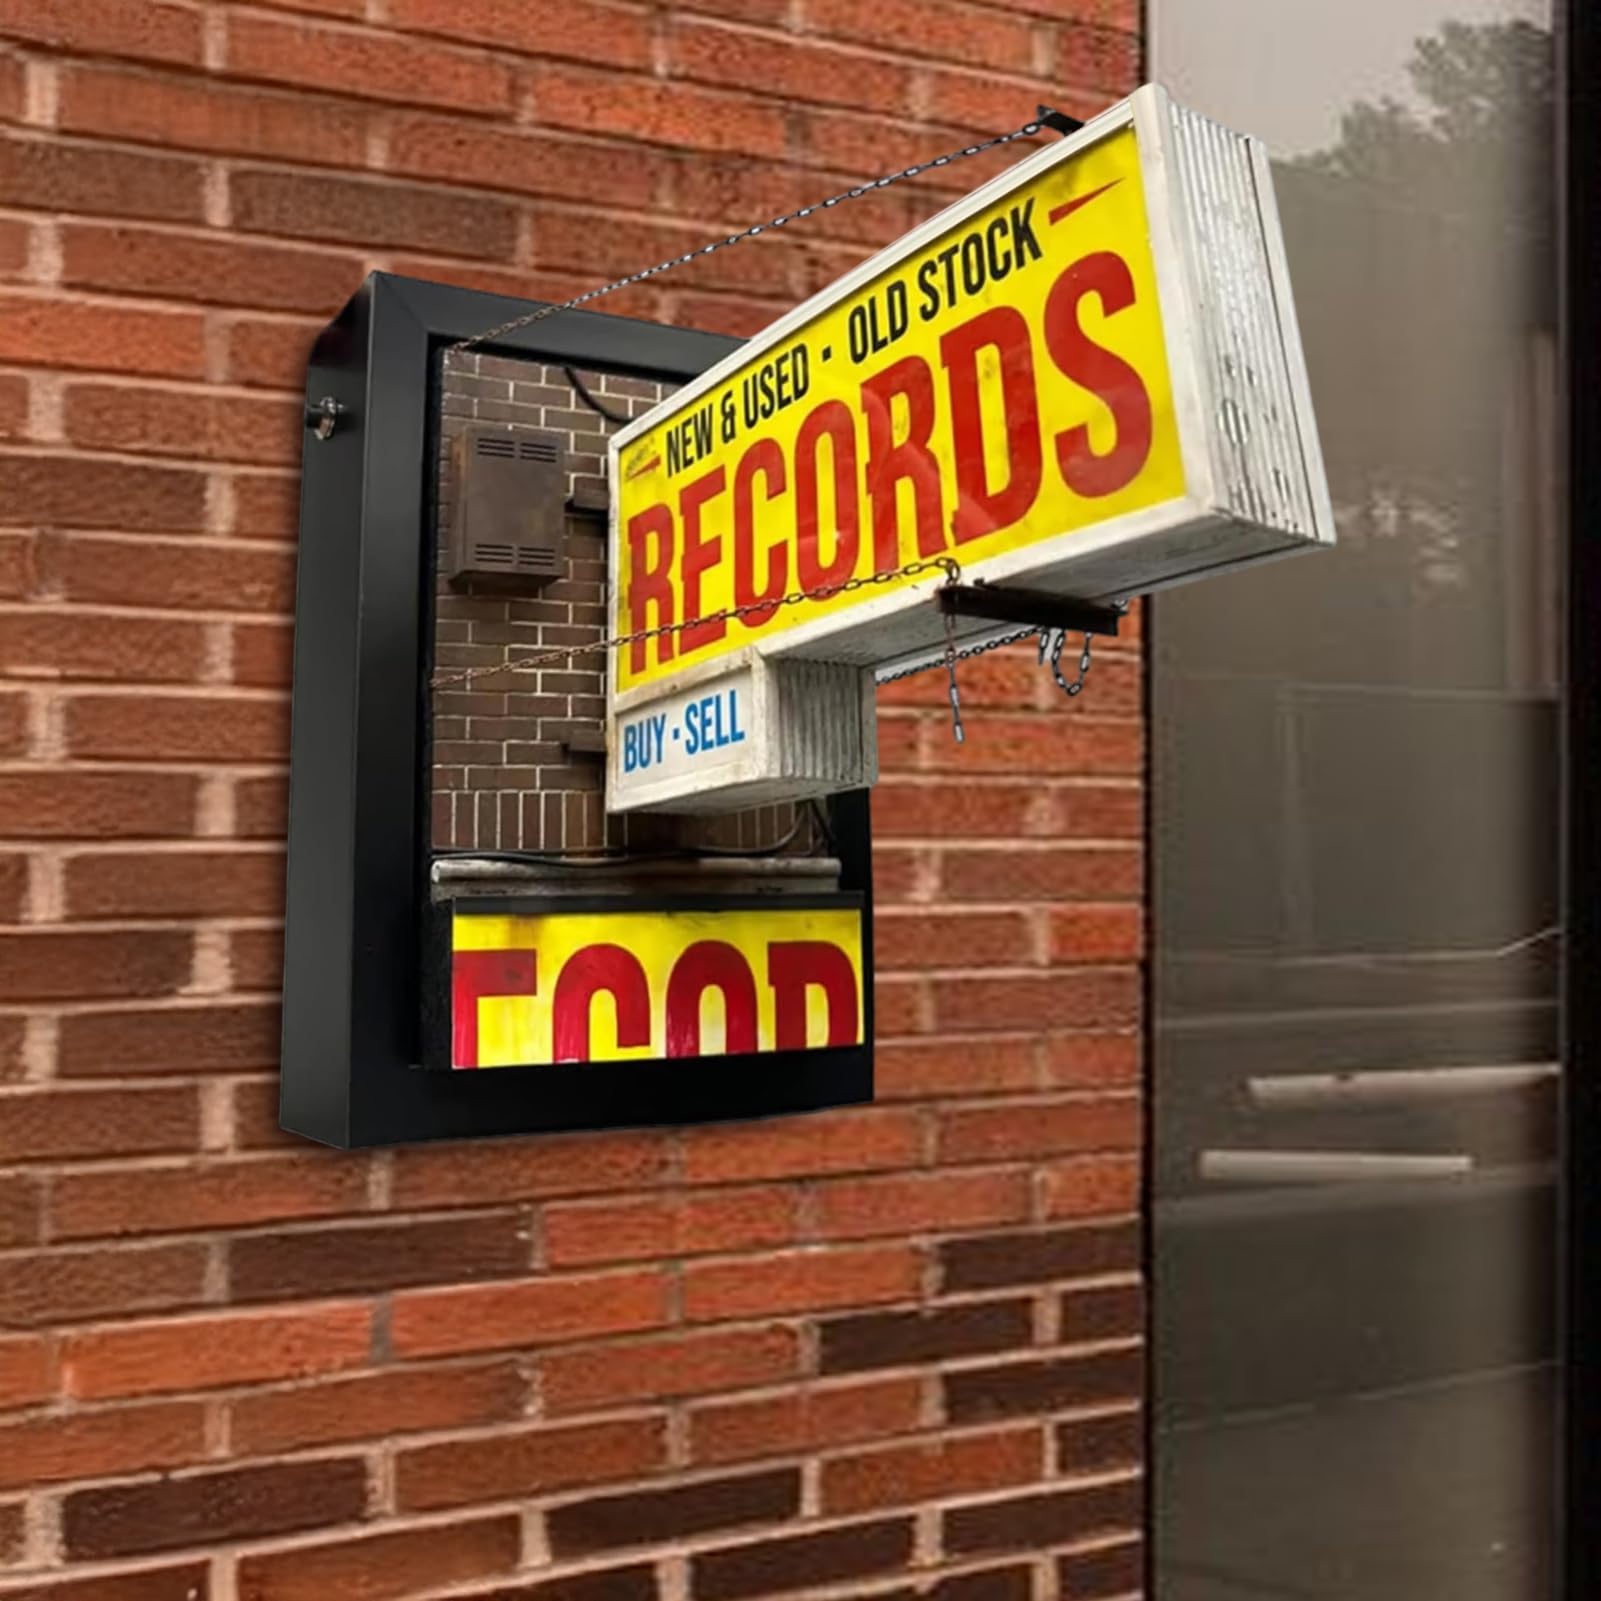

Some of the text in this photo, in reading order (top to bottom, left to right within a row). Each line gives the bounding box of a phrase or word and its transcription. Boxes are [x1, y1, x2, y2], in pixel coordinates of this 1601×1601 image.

[627, 250, 1153, 674] RECORDS
[665, 403, 714, 478] NEW
[720, 389, 736, 444] &
[743, 344, 809, 429] USED
[848, 280, 909, 365] OLD
[918, 197, 1043, 321] STOCK
[624, 713, 667, 773] BUY
[685, 689, 745, 755] SELL
